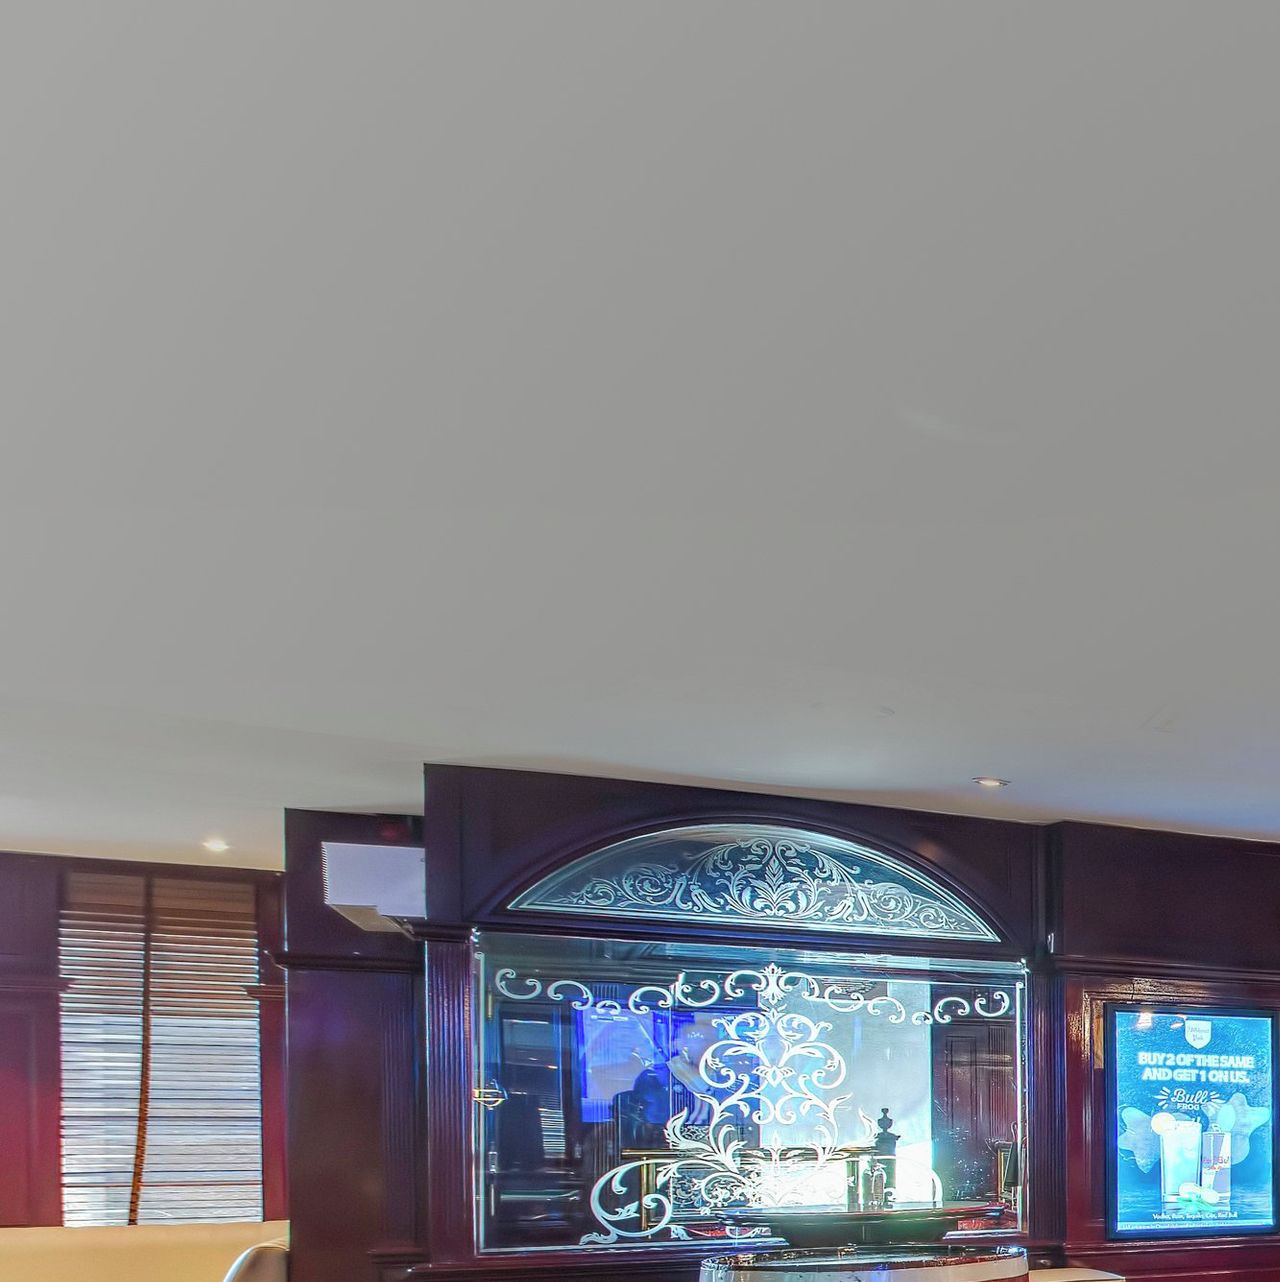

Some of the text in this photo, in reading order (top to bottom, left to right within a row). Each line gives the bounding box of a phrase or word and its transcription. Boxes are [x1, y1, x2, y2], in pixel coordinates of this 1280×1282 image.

[1138, 1052, 1255, 1068] BUY 2 OF THE SAME
[1142, 1068, 1250, 1083] AND GET 1 ON US.
[1171, 1088, 1208, 1105] Bull
